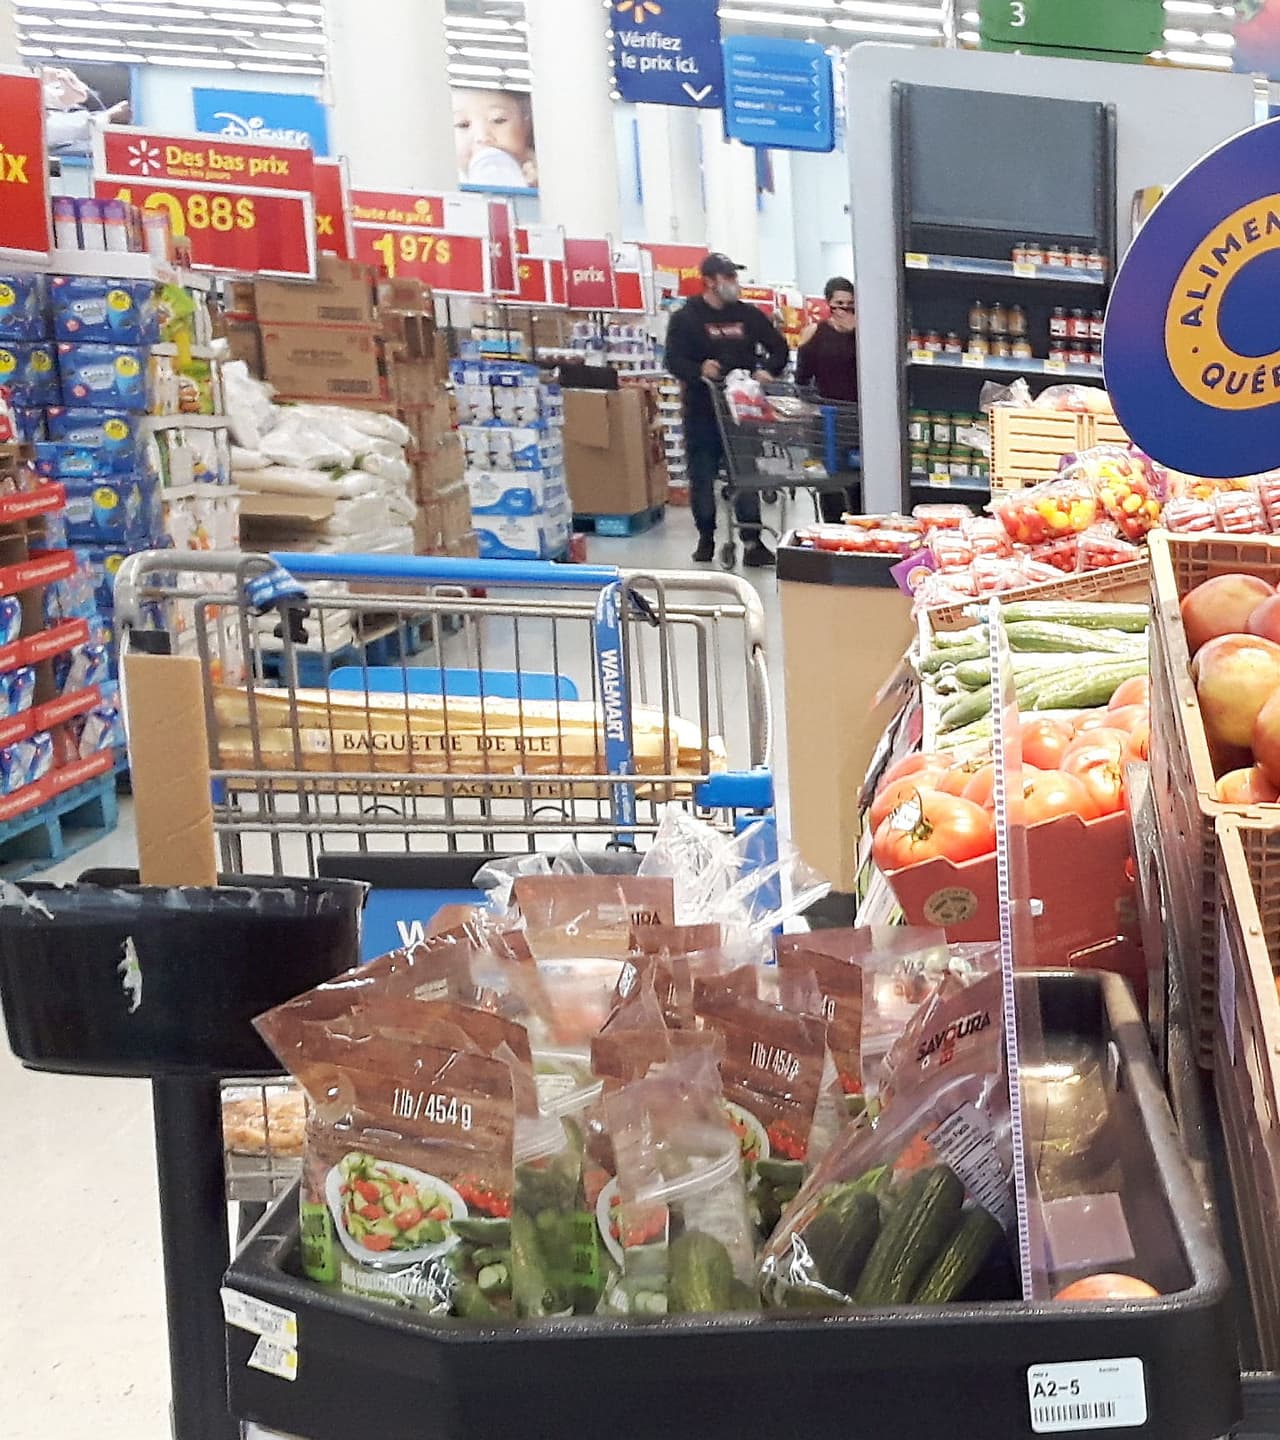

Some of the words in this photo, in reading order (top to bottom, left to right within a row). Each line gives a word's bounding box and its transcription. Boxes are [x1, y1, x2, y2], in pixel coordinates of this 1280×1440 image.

[1009, 2, 1027, 27] 3
[618, 30, 683, 50] Vérifiez
[621, 52, 638, 68] le
[640, 54, 673, 74] prix
[165, 146, 206, 167] Des
[208, 148, 245, 171] bas
[249, 154, 290, 177] prix
[600, 649, 625, 743] WALMART
[1032, 1379, 1081, 1399] A2-5
